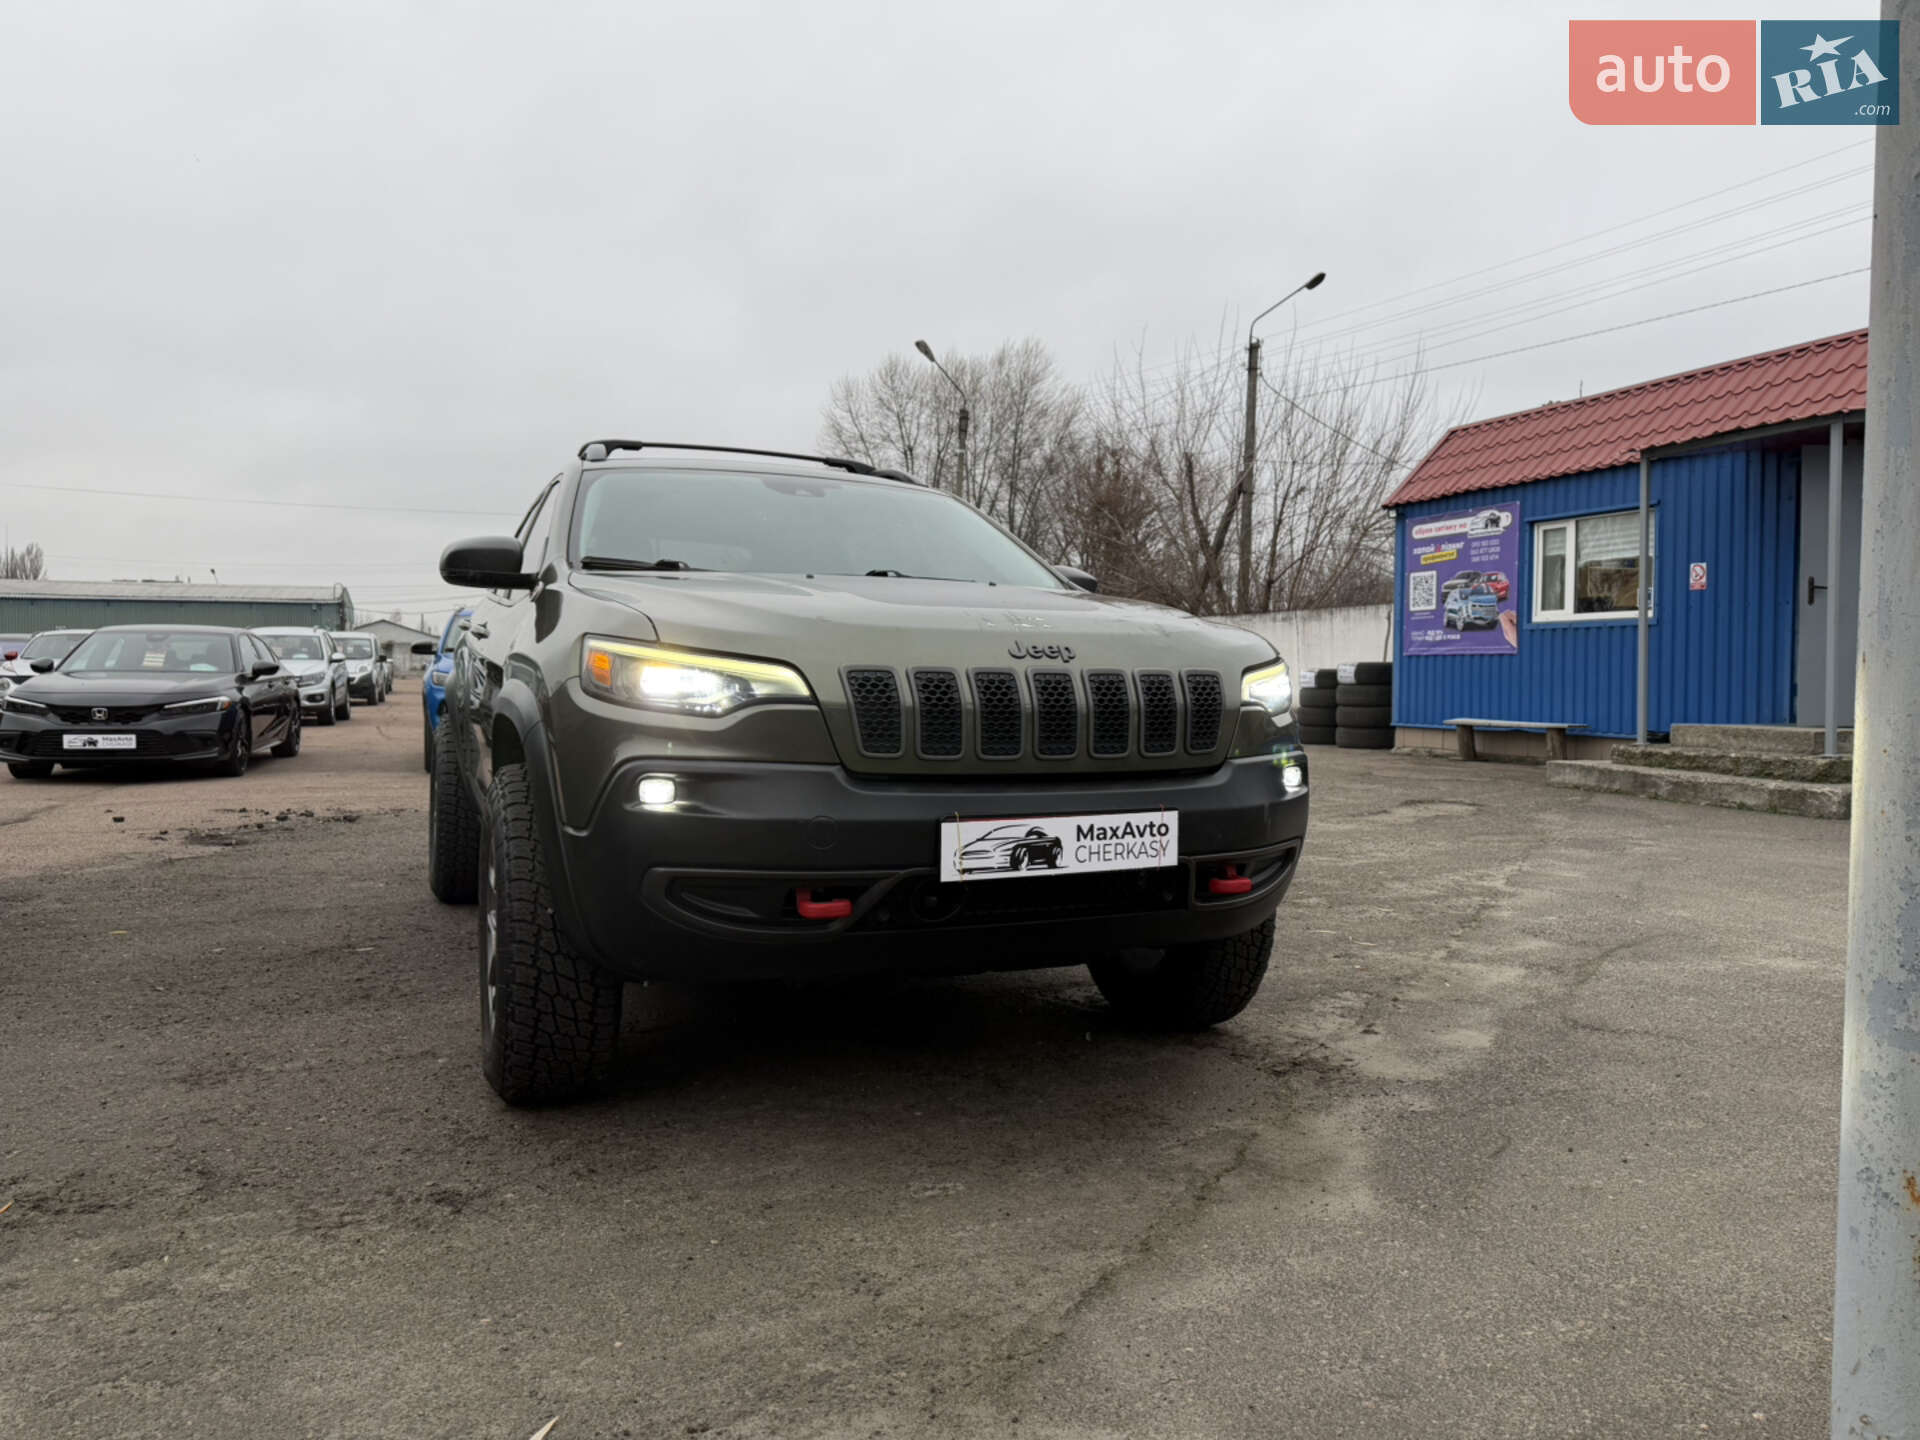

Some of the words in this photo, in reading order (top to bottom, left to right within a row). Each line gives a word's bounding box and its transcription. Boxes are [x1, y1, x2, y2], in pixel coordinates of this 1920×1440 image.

[1008, 640, 1076, 663] Jeep
[1076, 821, 1169, 842] MaxAvto
[1075, 840, 1170, 863] CHERKASY
